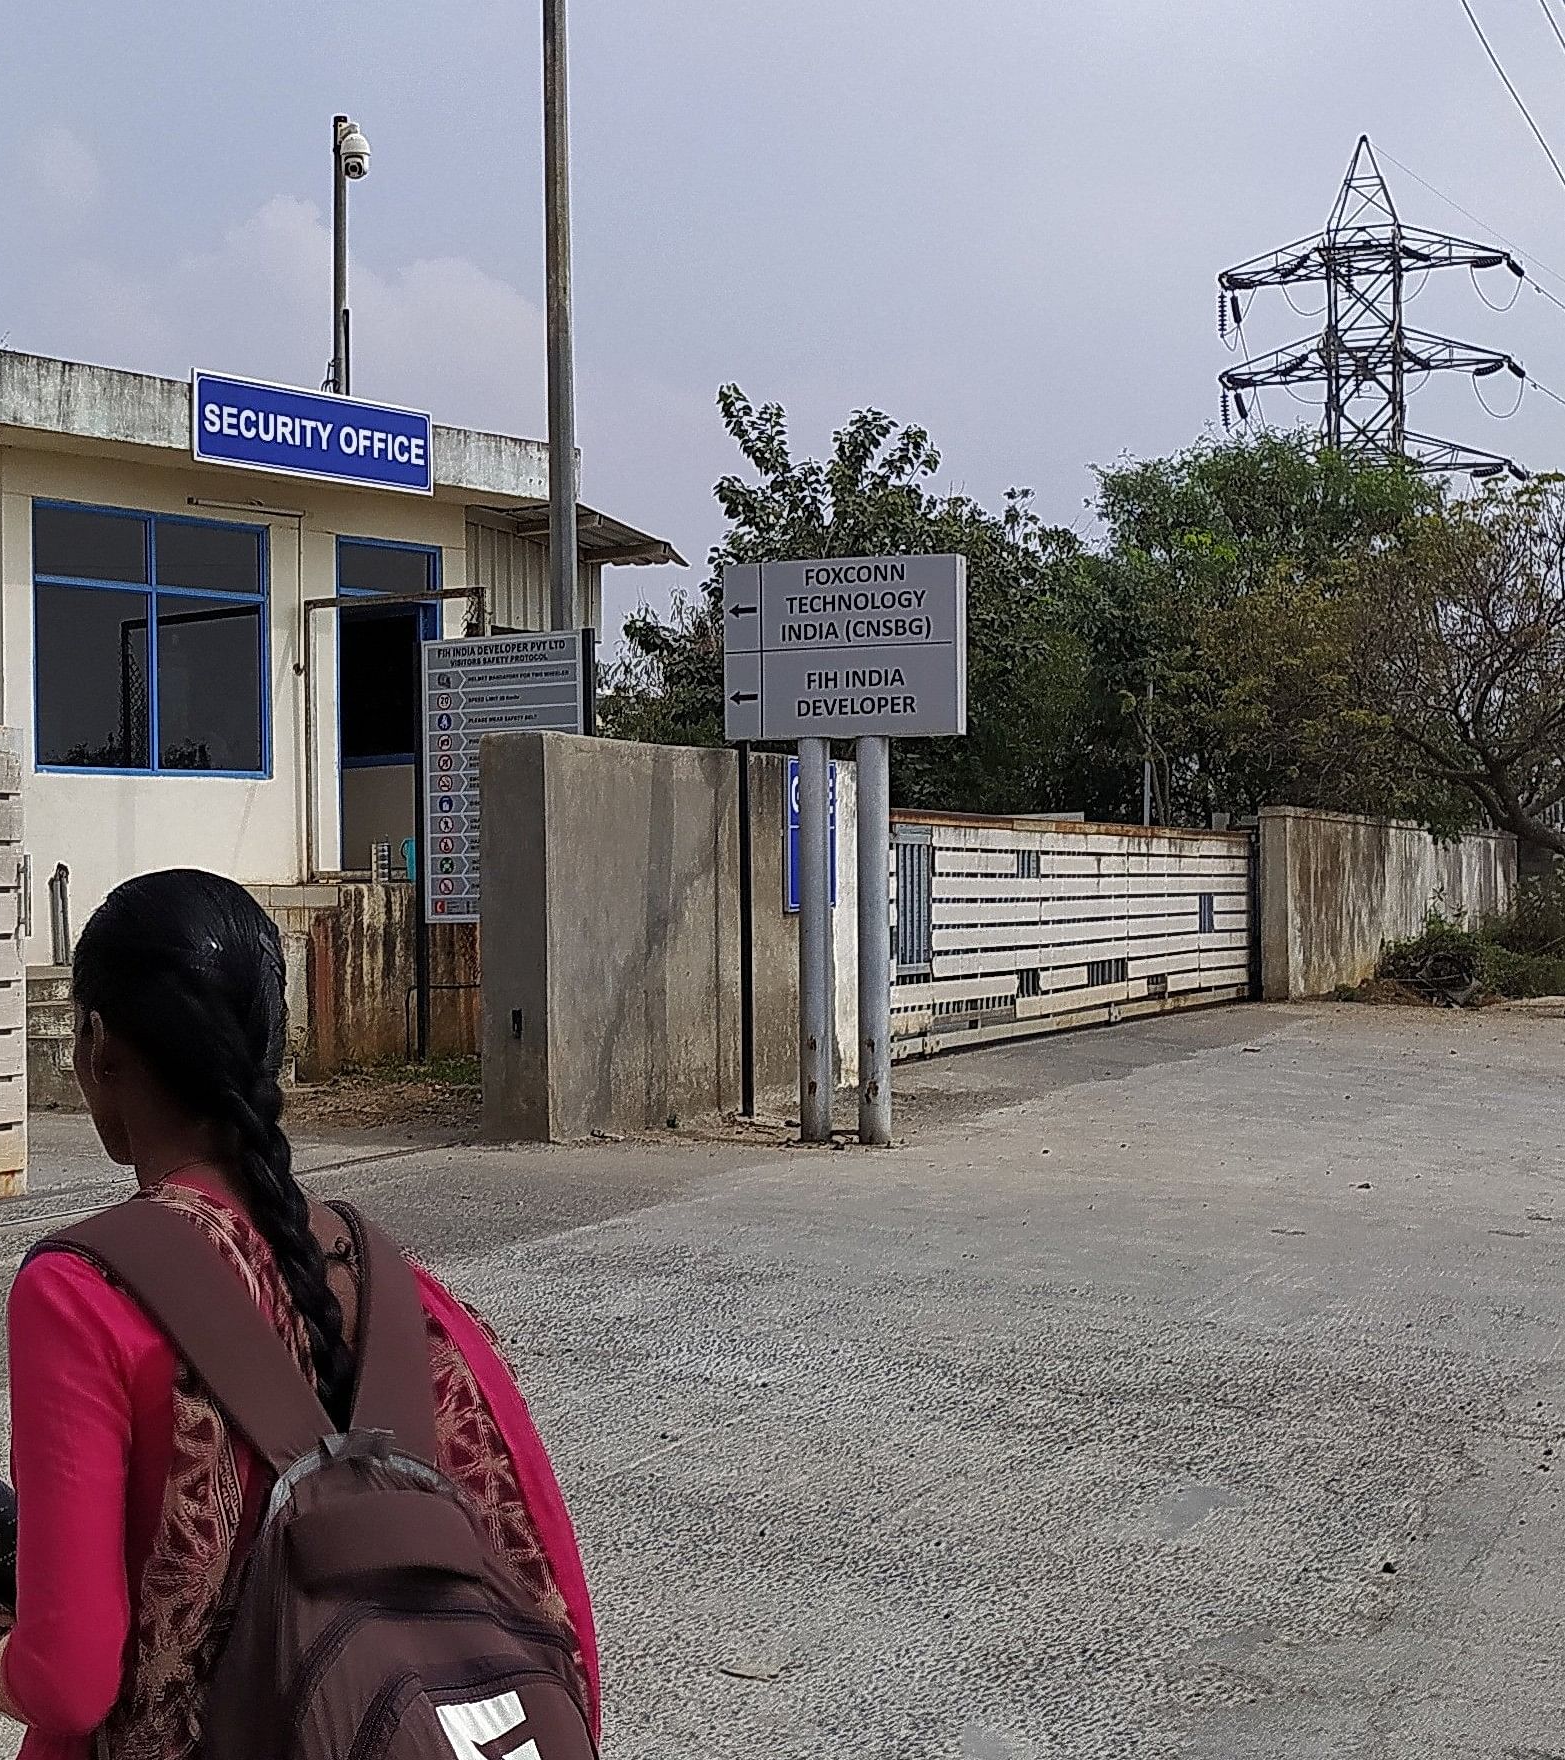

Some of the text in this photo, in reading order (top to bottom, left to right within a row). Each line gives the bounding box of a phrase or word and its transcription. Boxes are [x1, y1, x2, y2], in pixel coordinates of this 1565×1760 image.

[203, 403, 425, 465] SECURITY OFFICE
[804, 563, 906, 586] FOXCONN
[786, 589, 926, 615] TECHNOLOGY
[782, 616, 931, 643] INDIA (CNSBG)
[438, 639, 566, 658] FIH INDIA DEVELOPER PVT LTD
[450, 653, 548, 668] VISITORS SAFETY PROTOCOL
[807, 668, 905, 690] FIH INDIA
[797, 695, 916, 718] DEVELOPER
